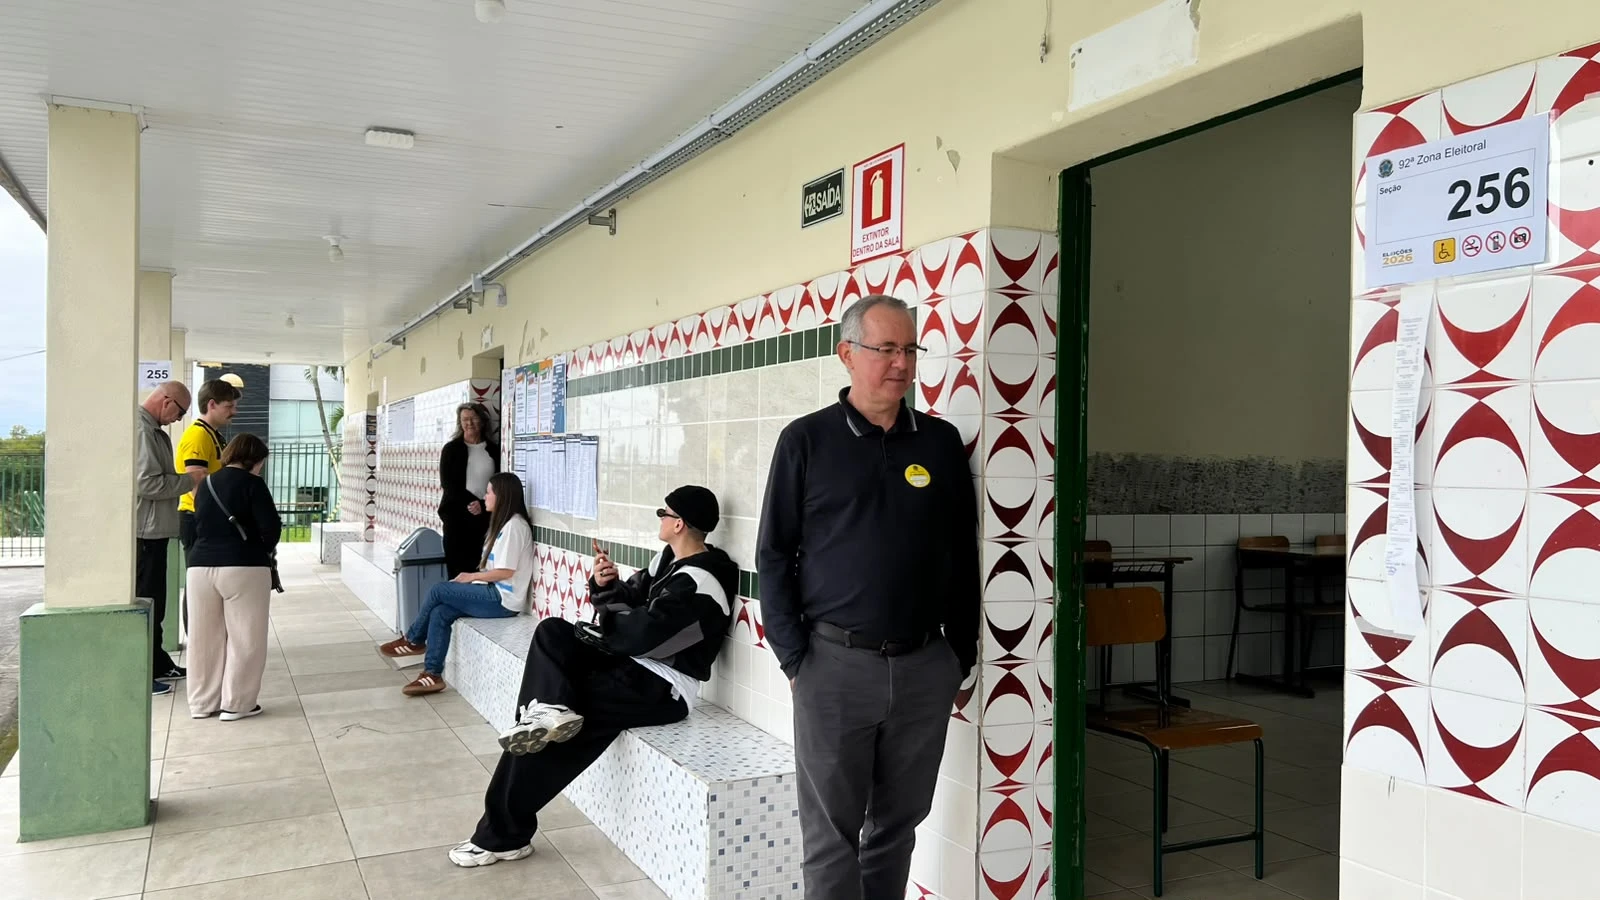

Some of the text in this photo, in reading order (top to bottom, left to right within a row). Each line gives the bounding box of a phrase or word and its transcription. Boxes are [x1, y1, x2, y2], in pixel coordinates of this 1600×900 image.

[1398, 139, 1487, 170] 92ª Zona Eleitoral
[816, 183, 841, 212] SAÍDA
[1379, 184, 1402, 195] Seção
[1447, 166, 1530, 221] 256
[862, 227, 890, 243] EXTINTOR
[852, 236, 900, 258] DENTRO DA SALA
[1382, 253, 1413, 265] 2026
[146, 369, 169, 379] 255
